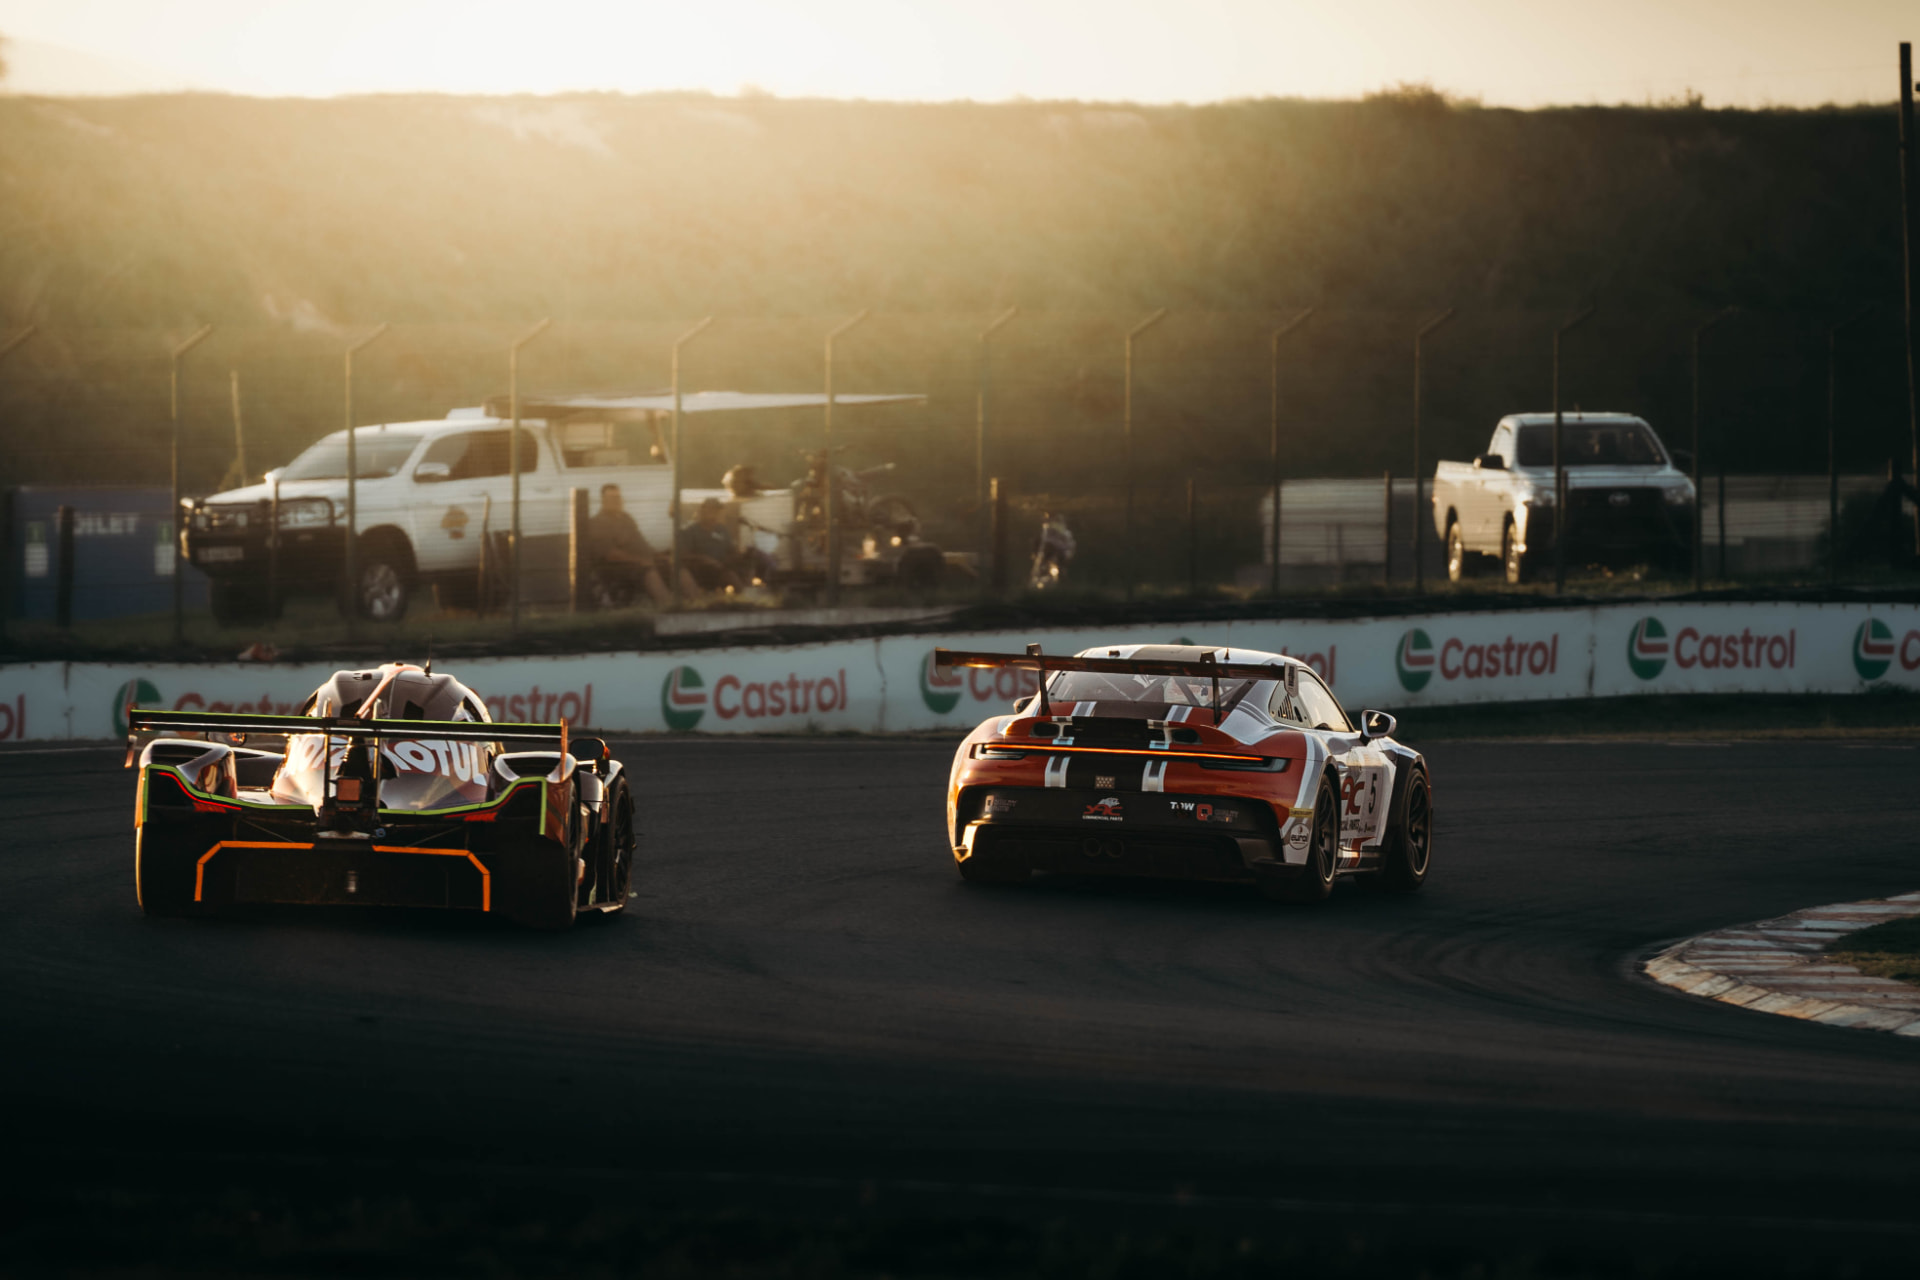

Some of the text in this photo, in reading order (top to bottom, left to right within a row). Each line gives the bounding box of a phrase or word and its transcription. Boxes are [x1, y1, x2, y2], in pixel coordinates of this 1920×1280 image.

[1440, 633, 1559, 681] Castrol
[1674, 626, 1796, 669] Castrol
[472, 683, 593, 728] astrol
[712, 668, 848, 720] Castrol
[1341, 775, 1366, 816] AC
[1368, 772, 1378, 815] 5
